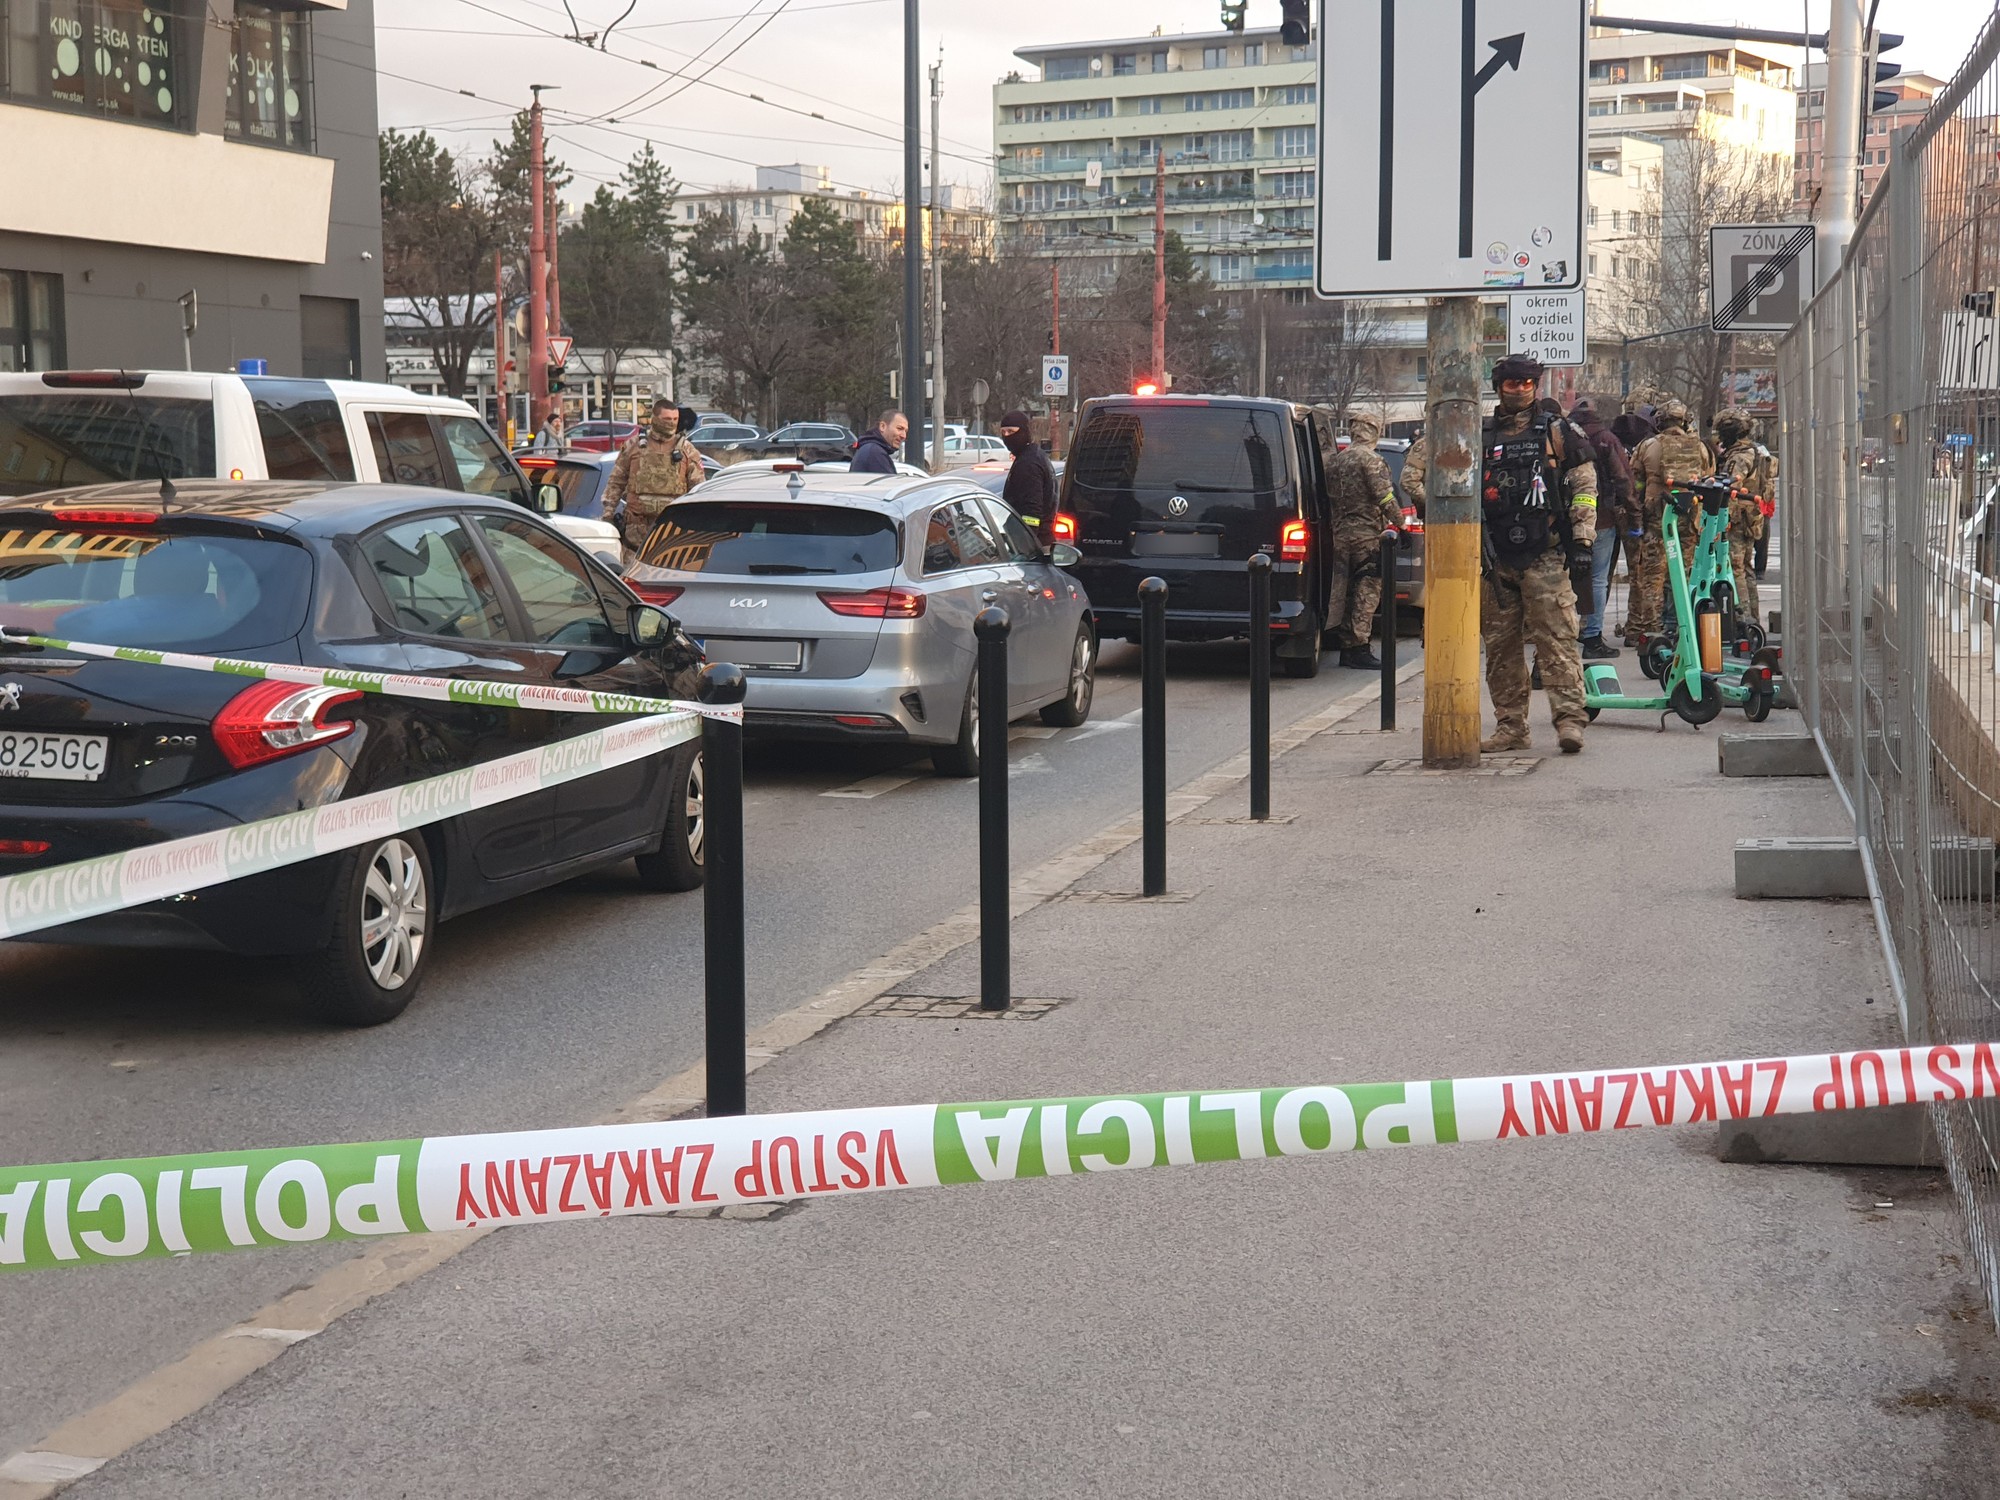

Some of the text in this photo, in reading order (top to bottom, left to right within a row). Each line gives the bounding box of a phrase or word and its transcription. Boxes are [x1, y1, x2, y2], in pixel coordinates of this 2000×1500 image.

[1742, 231, 1788, 250] ZÓNA
[1526, 296, 1568, 308] okrem
[1521, 312, 1573, 326] vozidiel
[1520, 327, 1574, 343] s dĺžkou
[1544, 347, 1570, 360] 10m
[155, 735, 197, 746] 208
[0, 735, 102, 771] 825GC
[1813, 1043, 2000, 1112] VSTUP
[734, 1129, 909, 1198] VSTUP
[455, 1143, 719, 1228] ZAKÁZANÝ
